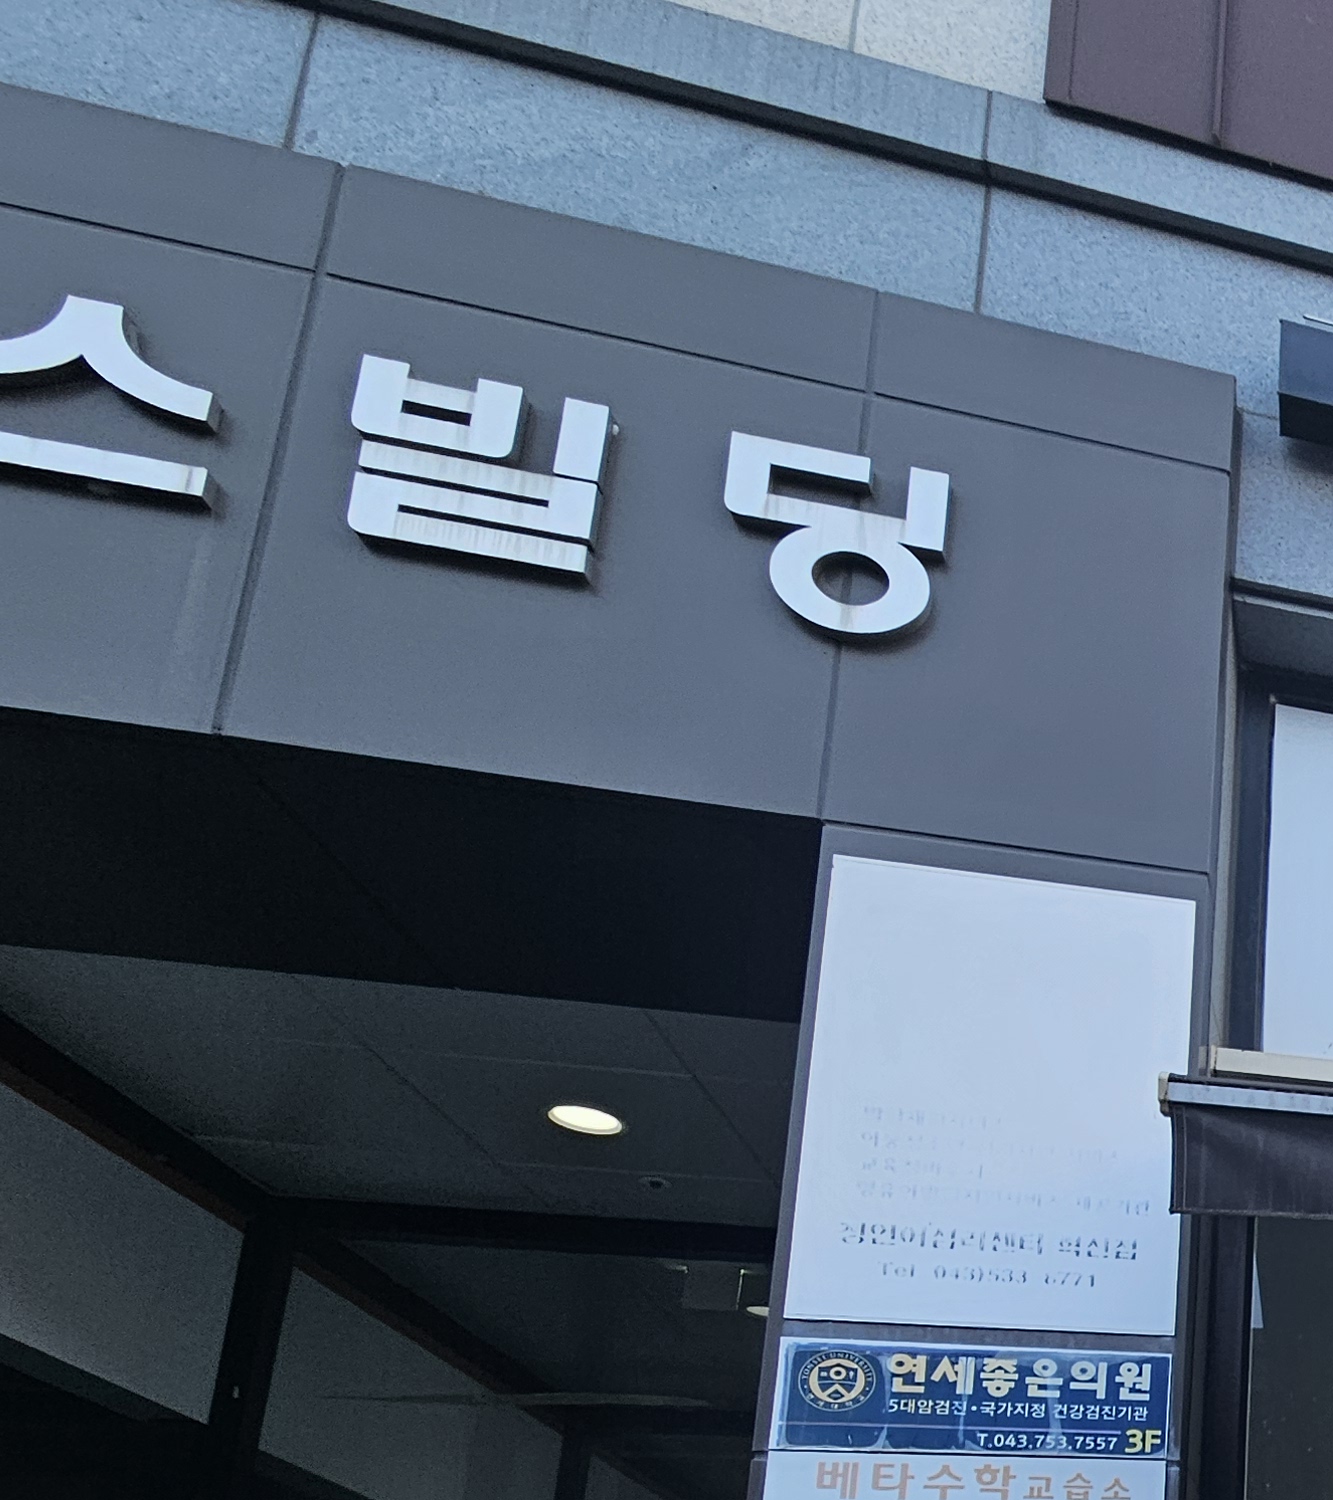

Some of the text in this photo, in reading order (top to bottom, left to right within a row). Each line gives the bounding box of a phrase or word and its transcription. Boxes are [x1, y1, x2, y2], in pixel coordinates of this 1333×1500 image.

[885, 1352, 1151, 1402] 연세좋은의원
[1052, 1402, 1149, 1422] 건강검진기관
[976, 1428, 1161, 1455] T.043.753.7557 3F
